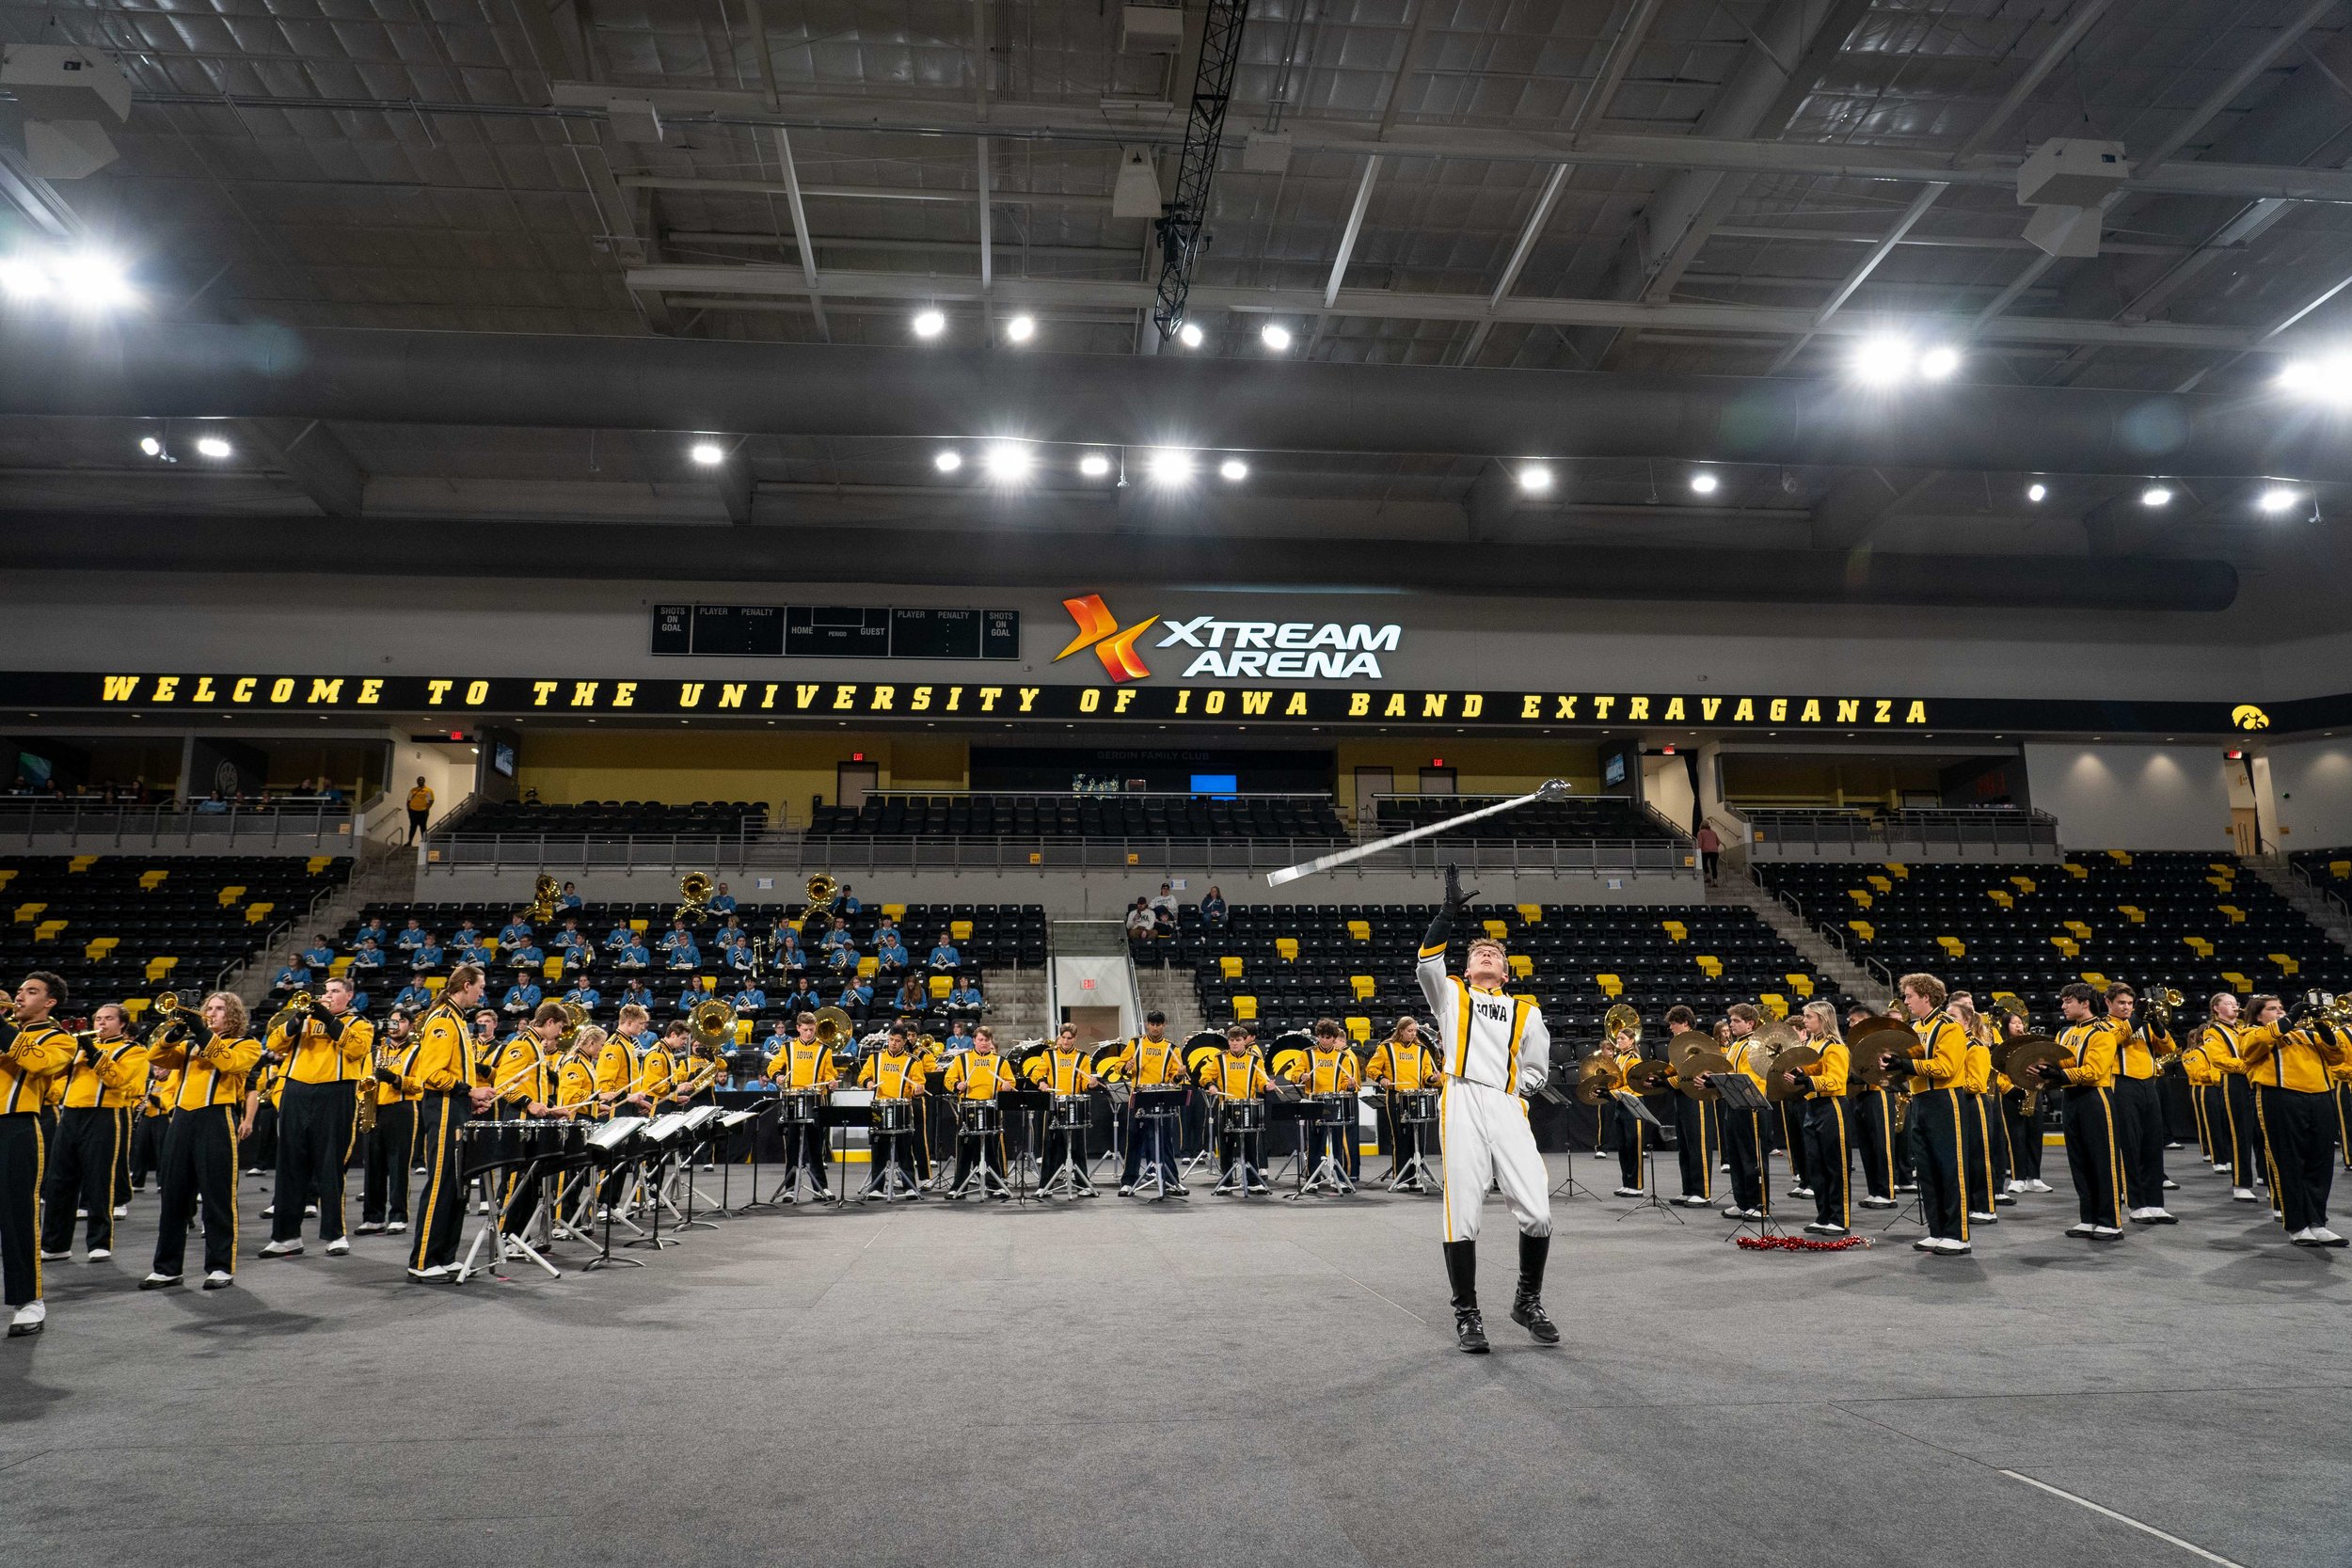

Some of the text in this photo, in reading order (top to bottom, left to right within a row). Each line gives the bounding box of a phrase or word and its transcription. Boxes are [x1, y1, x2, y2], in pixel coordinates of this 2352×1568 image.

[700, 608, 728, 616] PLAYER
[898, 610, 970, 620] PLAYER PENALTY
[667, 615, 677, 624] ON
[661, 624, 682, 632] GOAL
[791, 626, 814, 635] HOME
[860, 627, 885, 636] GUEST
[991, 628, 1011, 637] GOAL
[1155, 616, 1402, 651] XTREAM
[1182, 650, 1383, 679] ARENA
[103, 675, 1927, 723] WELCOME TO THE UNIVERSITY OF IOWA BAND EXTRAVAGANZA
[1141, 752, 1178, 760] FAMILY
[1182, 752, 1210, 761] CLUB
[1083, 979, 1095, 989] EXIT
[1476, 1003, 1507, 1022] IOWA
[796, 1051, 813, 1060] IOWA
[1146, 1047, 1162, 1056] IOWA
[1399, 1052, 1414, 1060] IOWA
[974, 1058, 991, 1068] IOWA
[1059, 1058, 1073, 1067] IOWA
[1230, 1061, 1246, 1070] IOWA
[882, 1063, 900, 1072] IOWA
